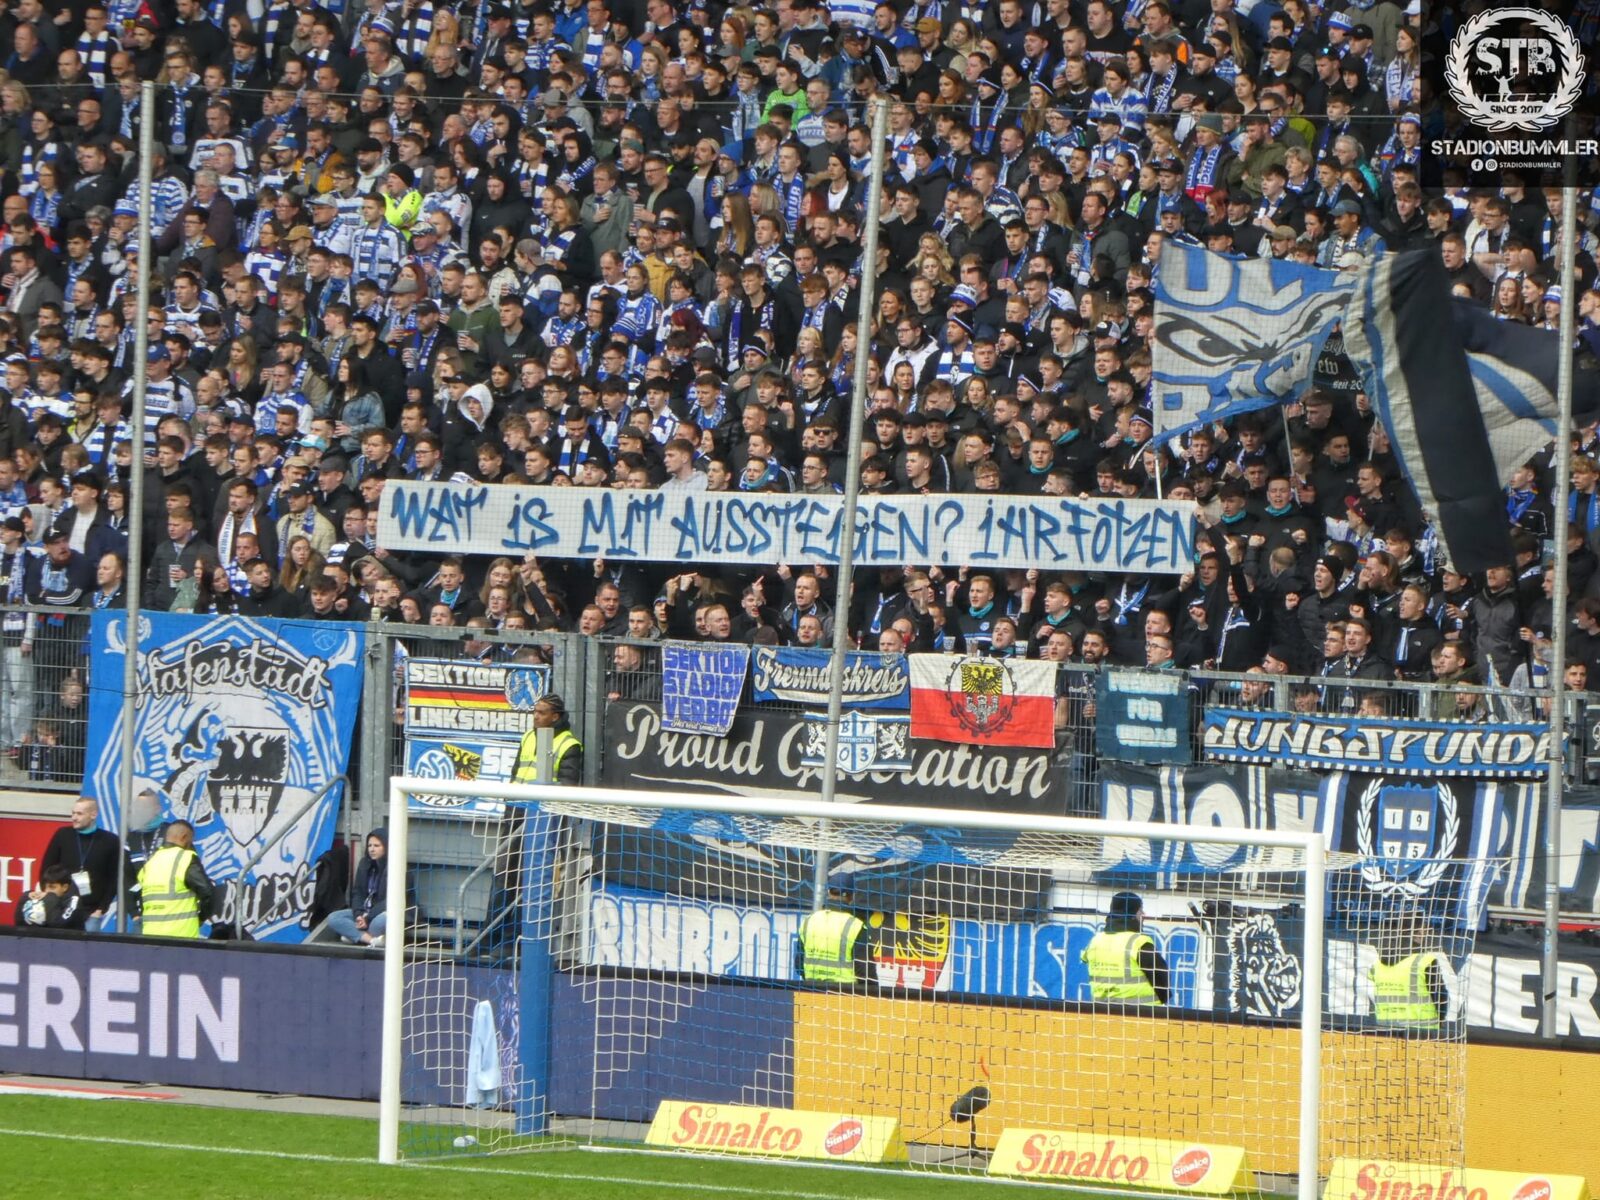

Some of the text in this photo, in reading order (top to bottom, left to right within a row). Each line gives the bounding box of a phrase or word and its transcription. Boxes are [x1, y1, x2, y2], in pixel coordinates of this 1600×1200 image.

[391, 486, 488, 542] WAT
[1060, 499, 1197, 569] FOTZEN
[409, 662, 507, 687] SEKTION
[662, 648, 746, 675] SEKTION
[754, 648, 908, 692] Freundskreis
[616, 703, 1052, 800] Proud Gration
[860, 747, 869, 762] 3
[671, 1104, 802, 1152] Sinalco
[825, 1126, 862, 1148] Sinalco
[1015, 1133, 1151, 1182] Sinalco
[1172, 1155, 1209, 1179] Sinalco
